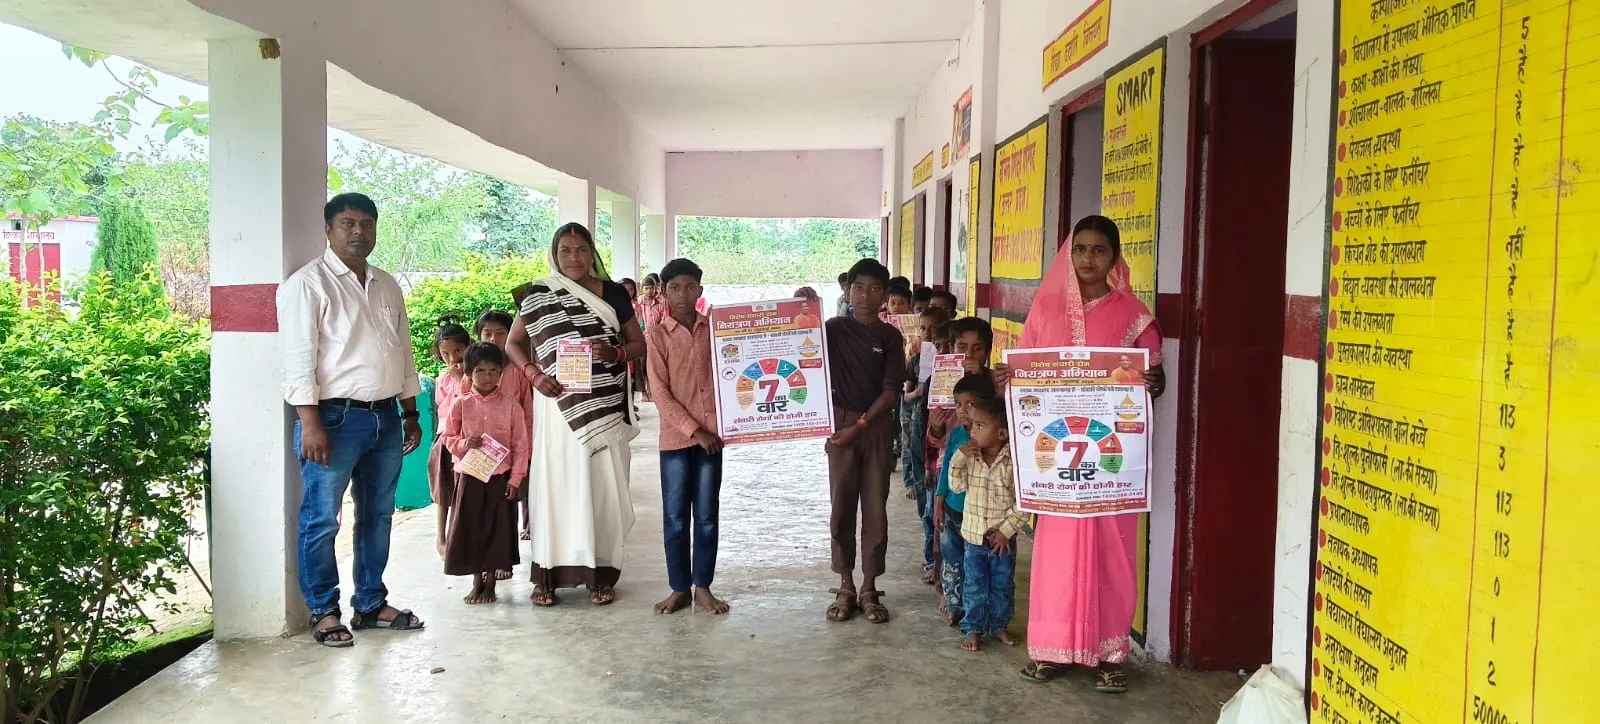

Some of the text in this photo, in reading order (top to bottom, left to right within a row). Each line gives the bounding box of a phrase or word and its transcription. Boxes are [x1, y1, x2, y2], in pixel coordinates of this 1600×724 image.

[1352, 35, 1382, 63] विद्यालय
[1391, 20, 1420, 49] उपलब्ध
[1421, 6, 1449, 35] भौतिक
[1521, 16, 1530, 40] 5
[1116, 66, 1155, 117] SMART
[1374, 163, 1381, 192] के
[1366, 201, 1372, 228] के
[1380, 236, 1390, 262] की
[1389, 269, 1399, 297] की
[717, 317, 790, 330] नियंत्रण अभियान
[1353, 305, 1362, 332] की
[1372, 339, 1383, 367] की
[1014, 367, 1108, 378] नियंत्रण अभियान
[758, 379, 779, 402] 7
[756, 400, 789, 413] वार
[1500, 404, 1515, 429] 113
[1062, 441, 1088, 469] 7
[1498, 446, 1505, 471] 3
[1031, 482, 1055, 490] संचारी
[1056, 482, 1077, 490] रोगों
[1079, 481, 1091, 490] की
[1093, 481, 1114, 489] होगी
[1057, 467, 1099, 481] वार
[1496, 489, 1512, 516] 113
[1494, 530, 1510, 558] 113
[1494, 576, 1500, 597] 0
[1491, 616, 1495, 643] 1
[1487, 660, 1496, 687] 2
